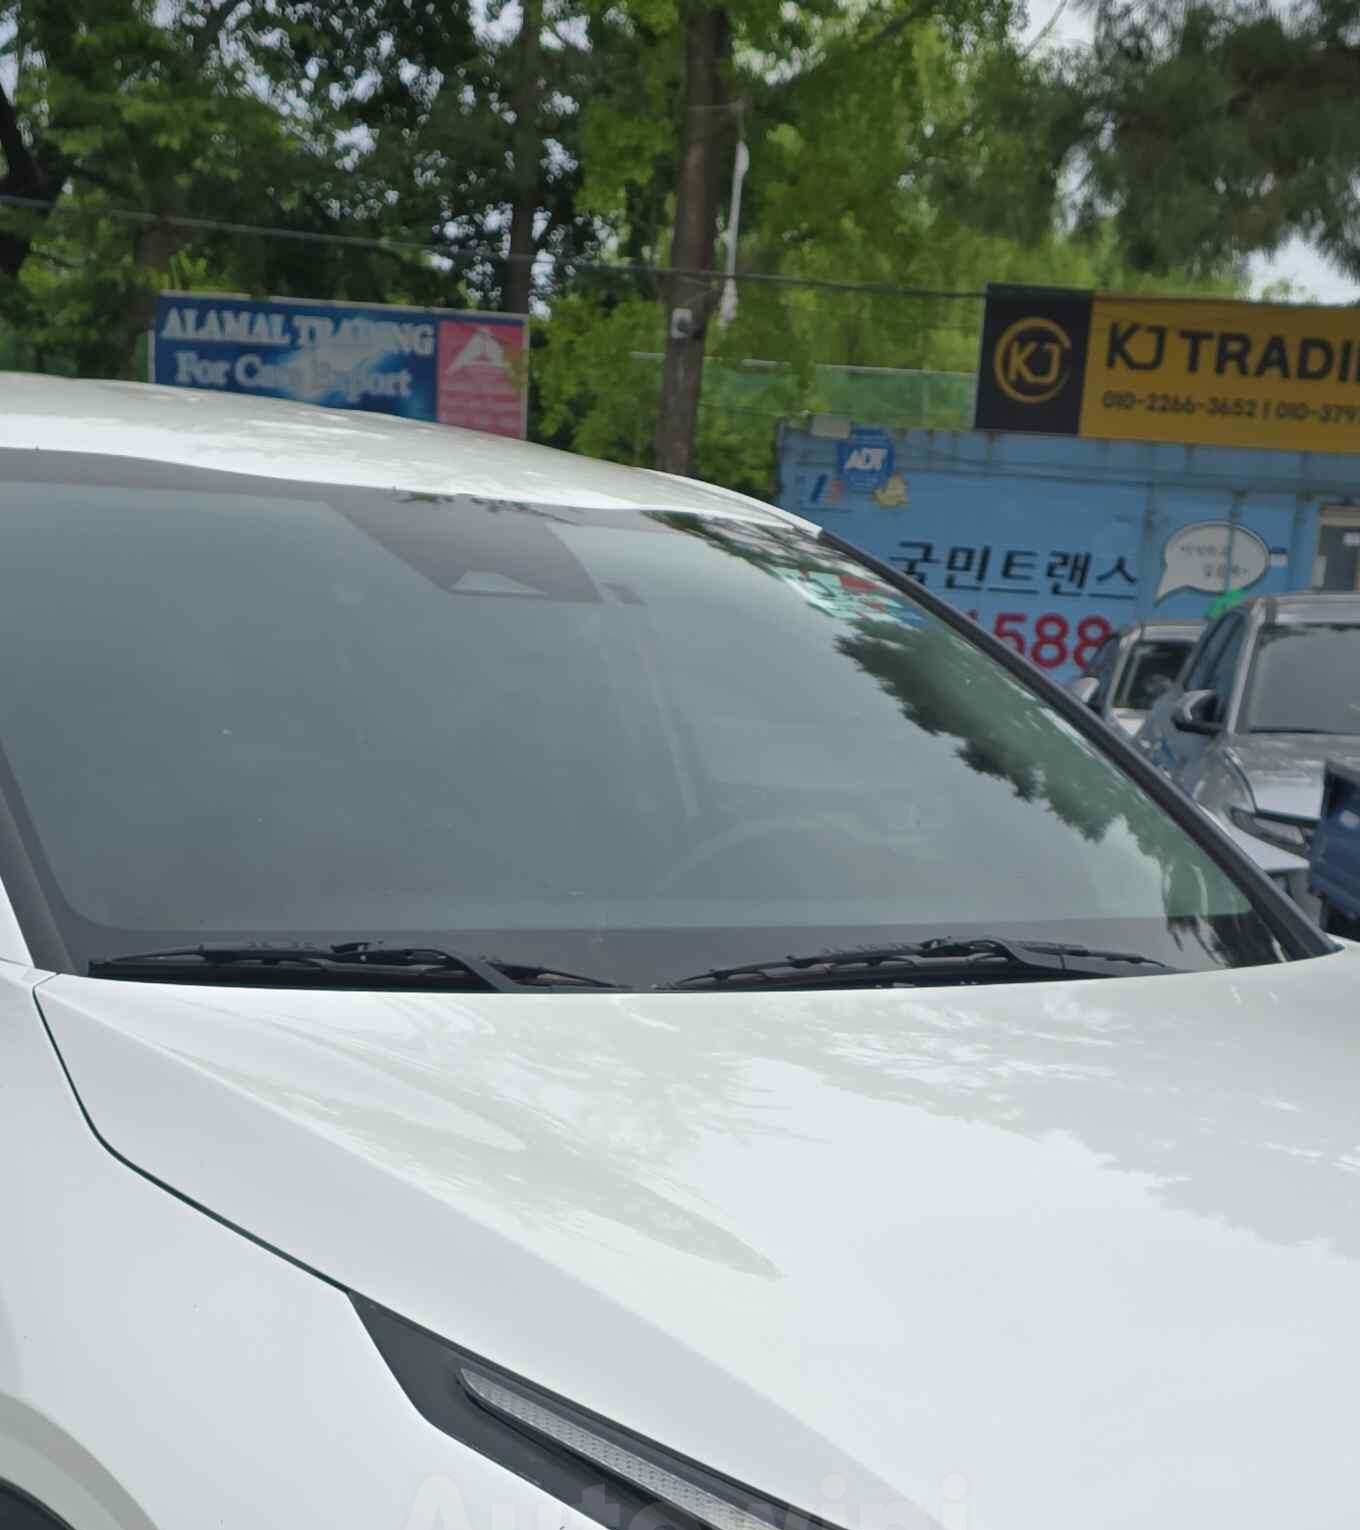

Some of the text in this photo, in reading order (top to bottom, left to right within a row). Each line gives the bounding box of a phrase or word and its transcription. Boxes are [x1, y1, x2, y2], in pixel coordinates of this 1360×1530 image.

[161, 307, 435, 356] ALAMAL TRADING
[1106, 322, 1167, 371] KJ
[843, 448, 890, 471] ADT
[890, 540, 1139, 600] 국민트랜스
[962, 608, 1114, 672] 588
